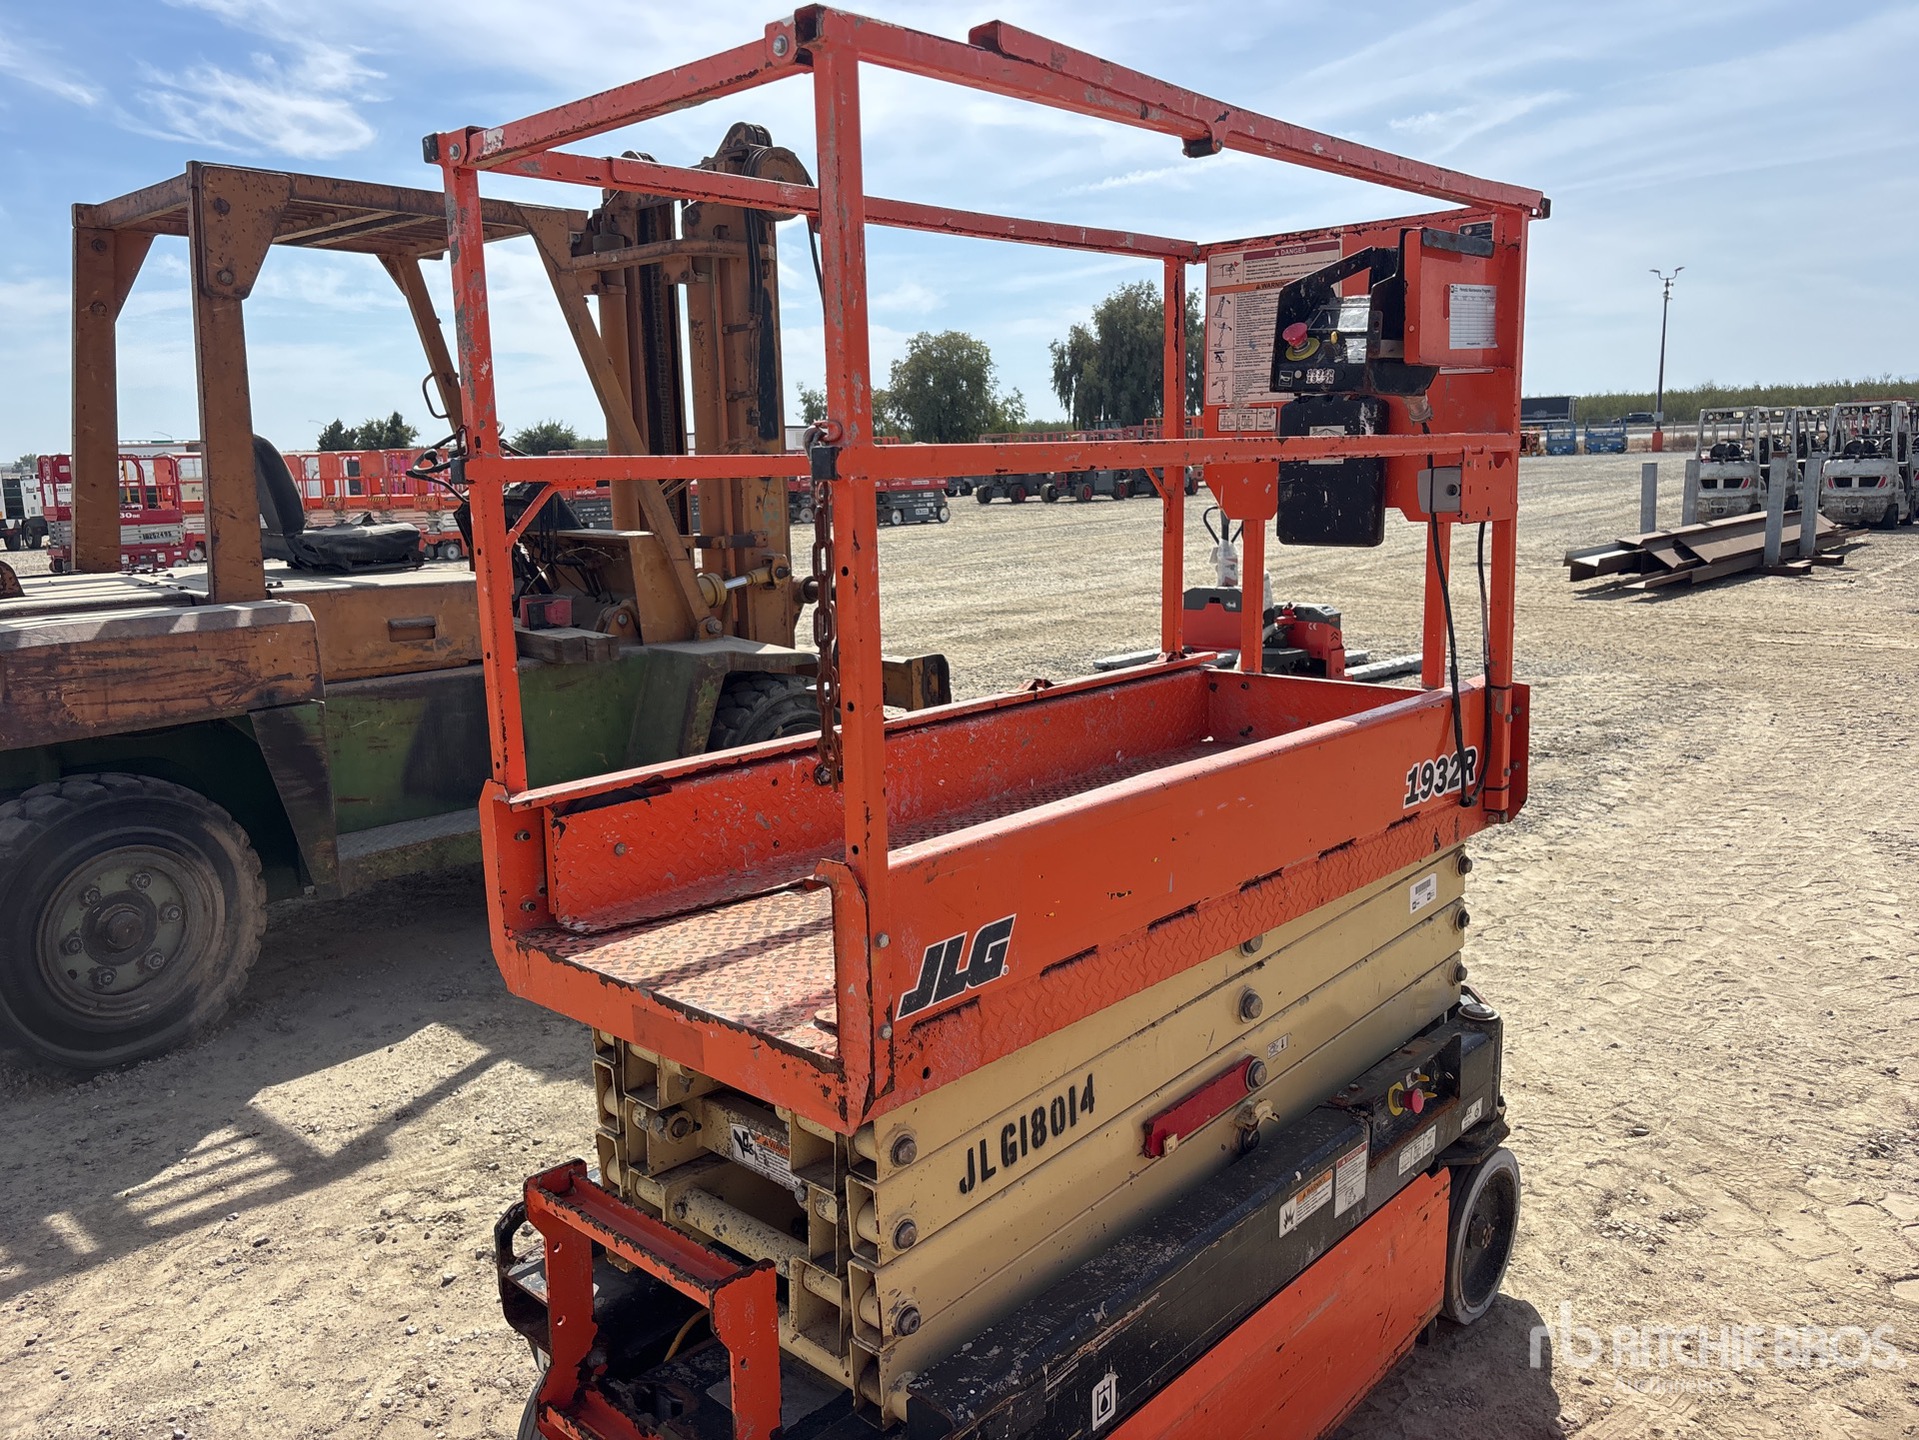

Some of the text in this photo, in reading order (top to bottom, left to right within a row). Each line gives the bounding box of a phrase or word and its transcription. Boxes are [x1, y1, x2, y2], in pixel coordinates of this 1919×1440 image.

[1280, 246, 1307, 256] DANGER
[1403, 745, 1478, 809] 1932R
[895, 913, 1017, 1021] JLG
